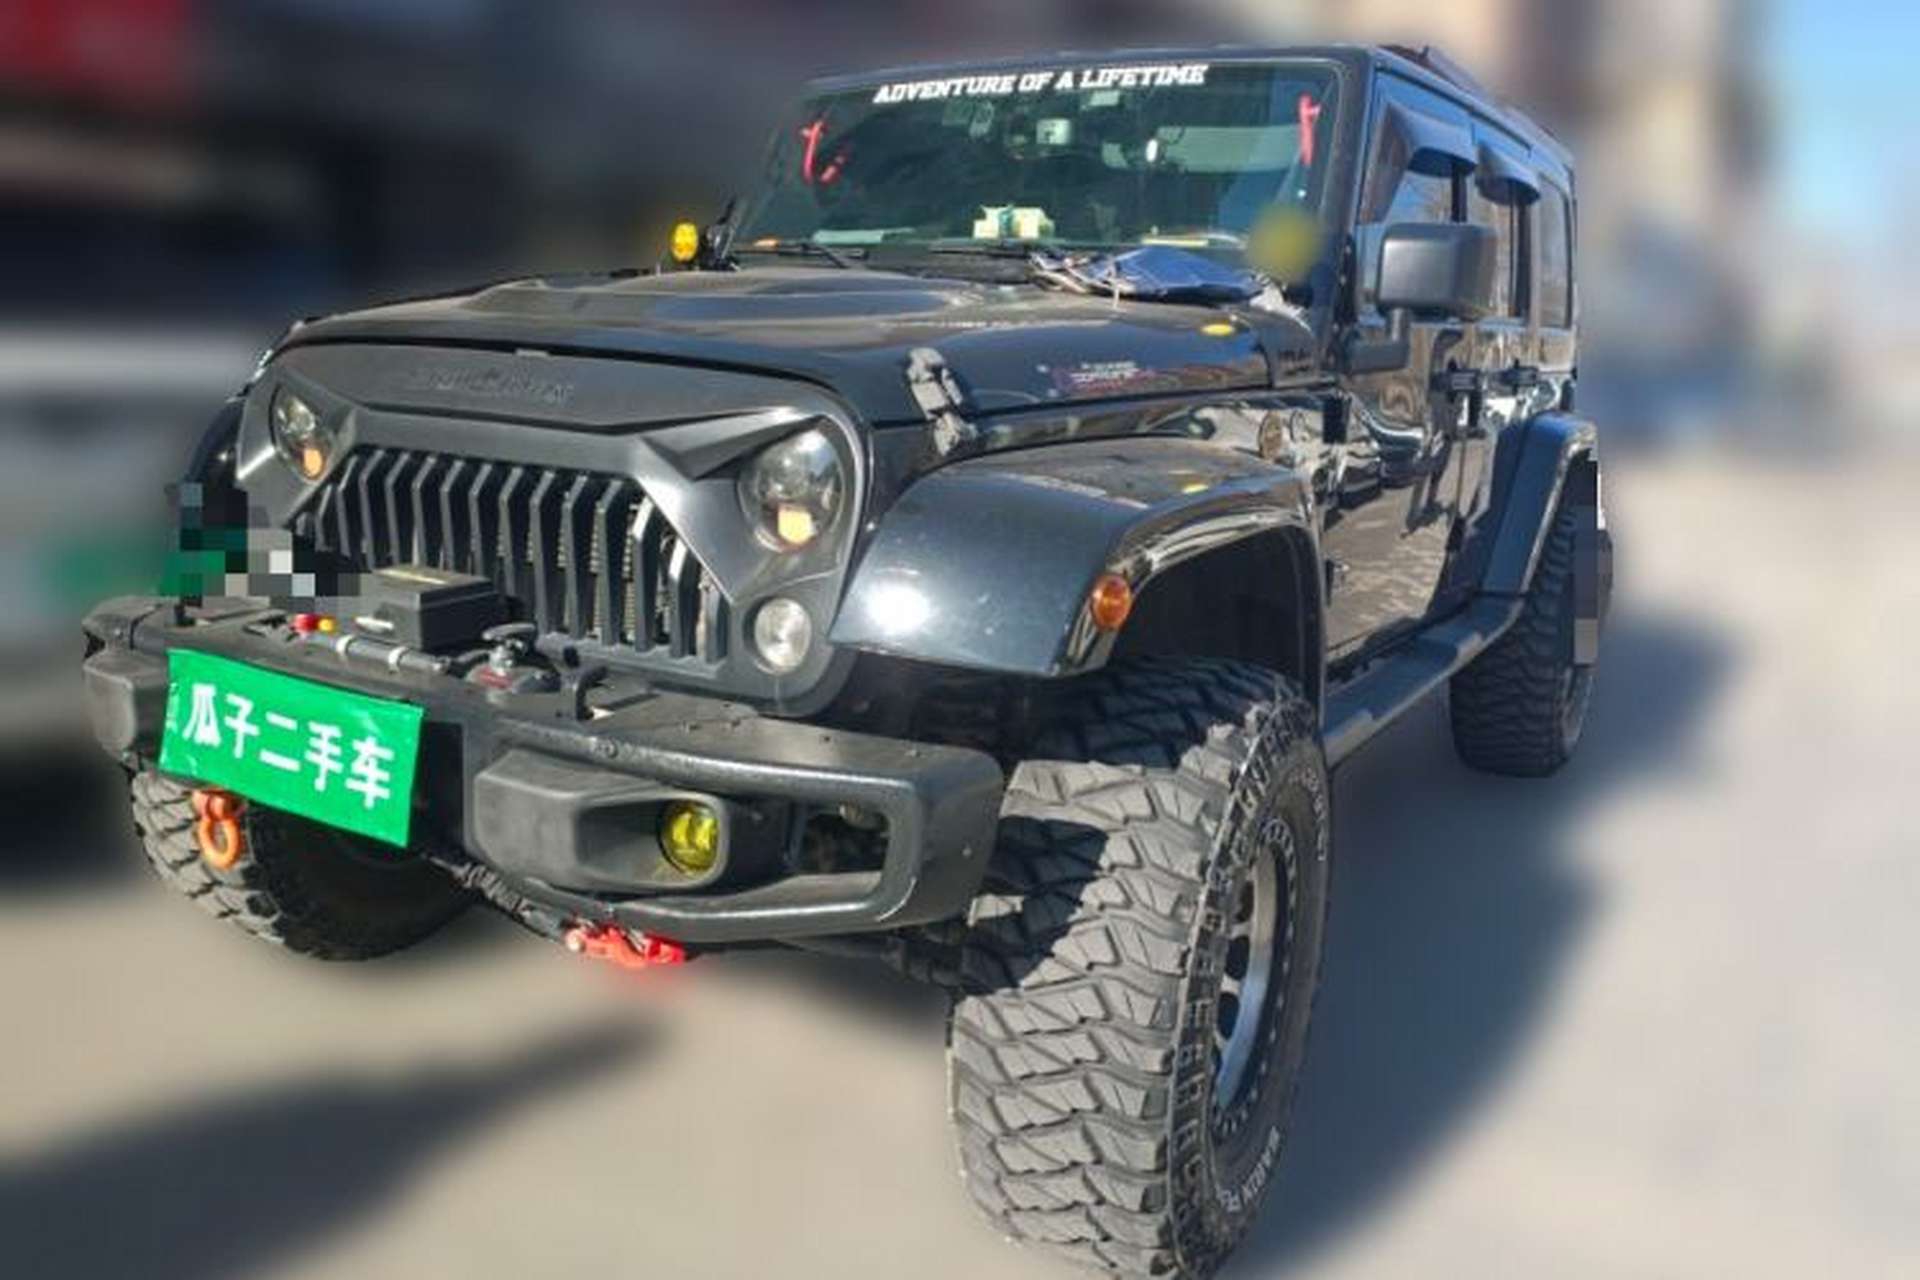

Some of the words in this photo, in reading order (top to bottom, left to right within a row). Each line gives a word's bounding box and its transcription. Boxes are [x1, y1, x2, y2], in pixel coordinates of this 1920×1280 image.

[873, 76, 1014, 103] ADVENTURE
[1018, 72, 1053, 91] OF
[1055, 71, 1074, 90] A
[1080, 64, 1207, 87] LIFETIME
[182, 683, 395, 809] 瓜子二手车
